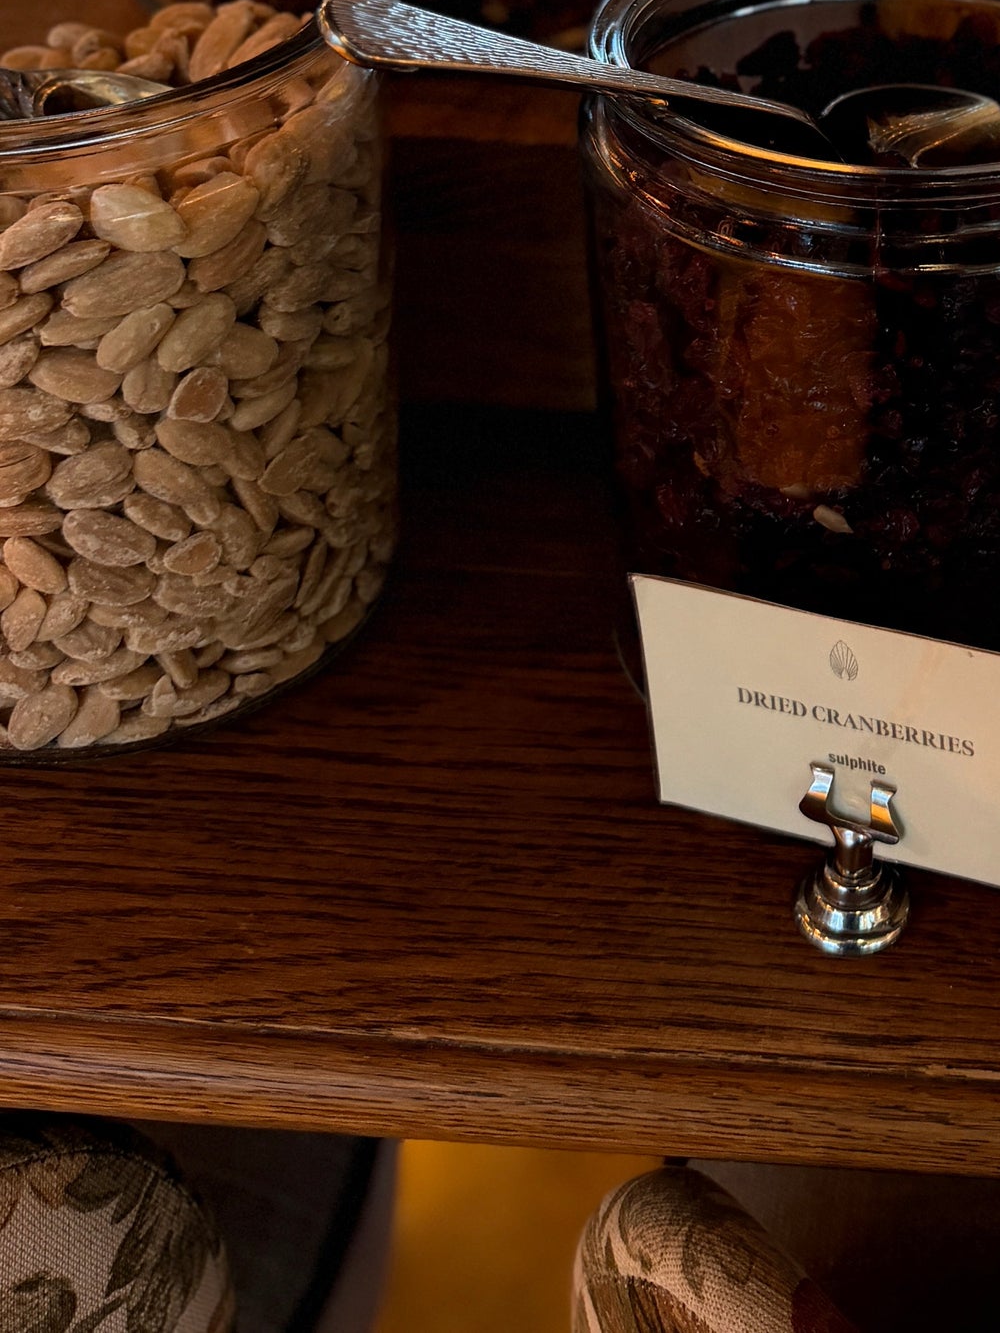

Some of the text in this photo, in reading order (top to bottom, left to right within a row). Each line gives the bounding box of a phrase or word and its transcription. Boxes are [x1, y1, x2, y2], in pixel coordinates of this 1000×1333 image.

[737, 686, 975, 757] DRIED CRANBERRIES
[828, 751, 887, 776] sulphite
